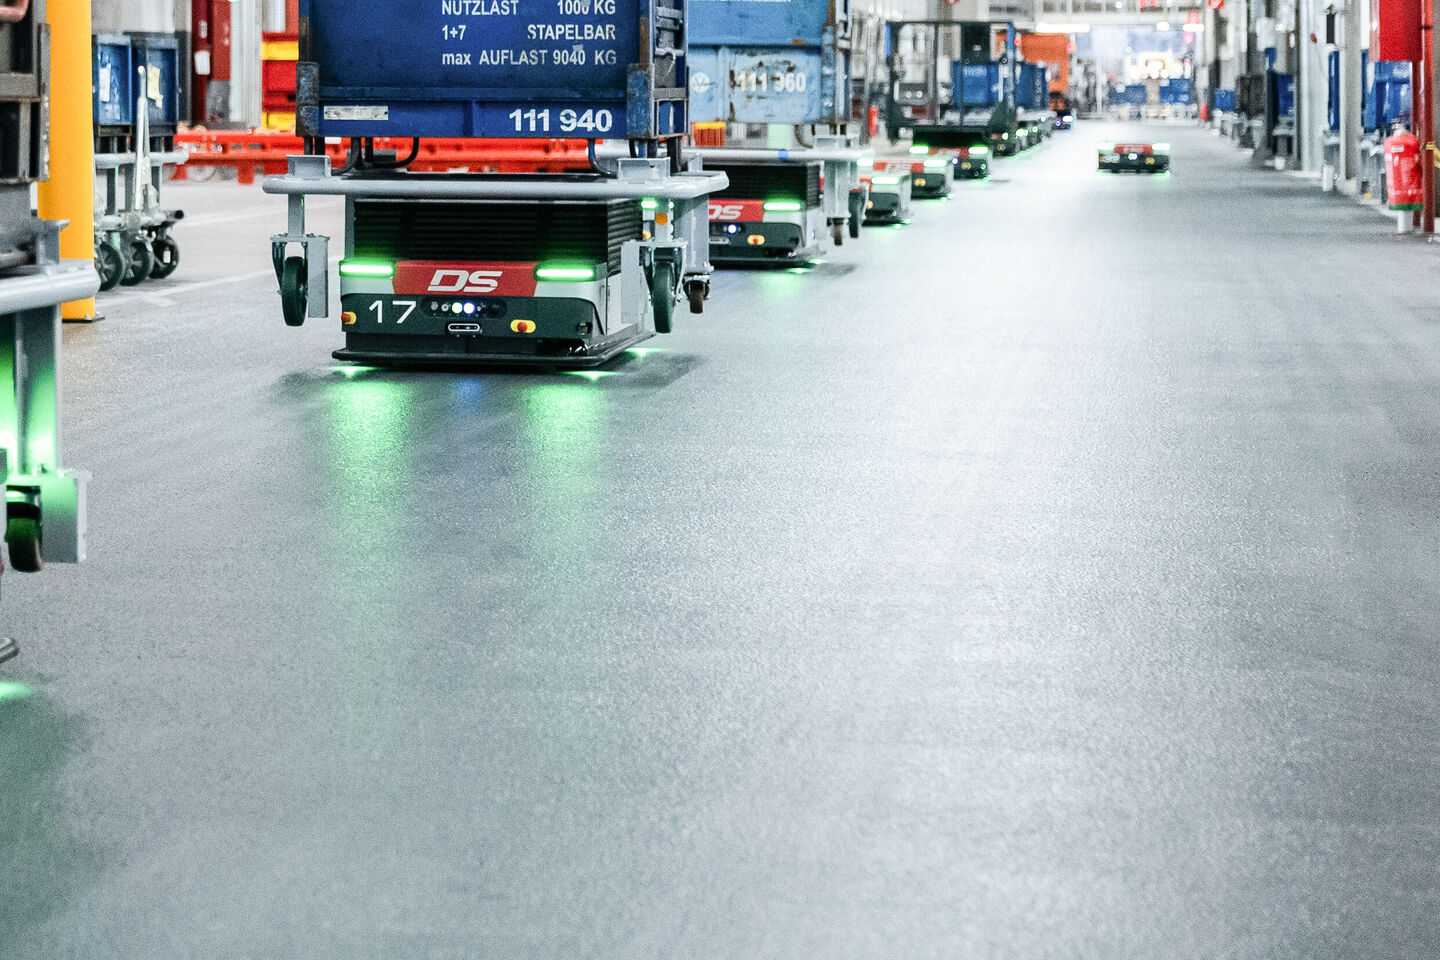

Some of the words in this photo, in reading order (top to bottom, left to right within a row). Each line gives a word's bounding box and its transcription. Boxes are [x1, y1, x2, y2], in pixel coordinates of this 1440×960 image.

[442, 0, 519, 16] NUTZLAST
[594, 0, 616, 15] KG
[442, 24, 467, 41] 1+7
[527, 24, 616, 40] STAPELBAR
[442, 53, 471, 65] max
[479, 49, 548, 65] AUFLAST
[553, 49, 586, 65] 9040
[594, 50, 617, 65] KG
[509, 108, 550, 132] 111
[559, 109, 613, 133] 940
[427, 269, 503, 293] DS
[369, 300, 417, 324] 17
